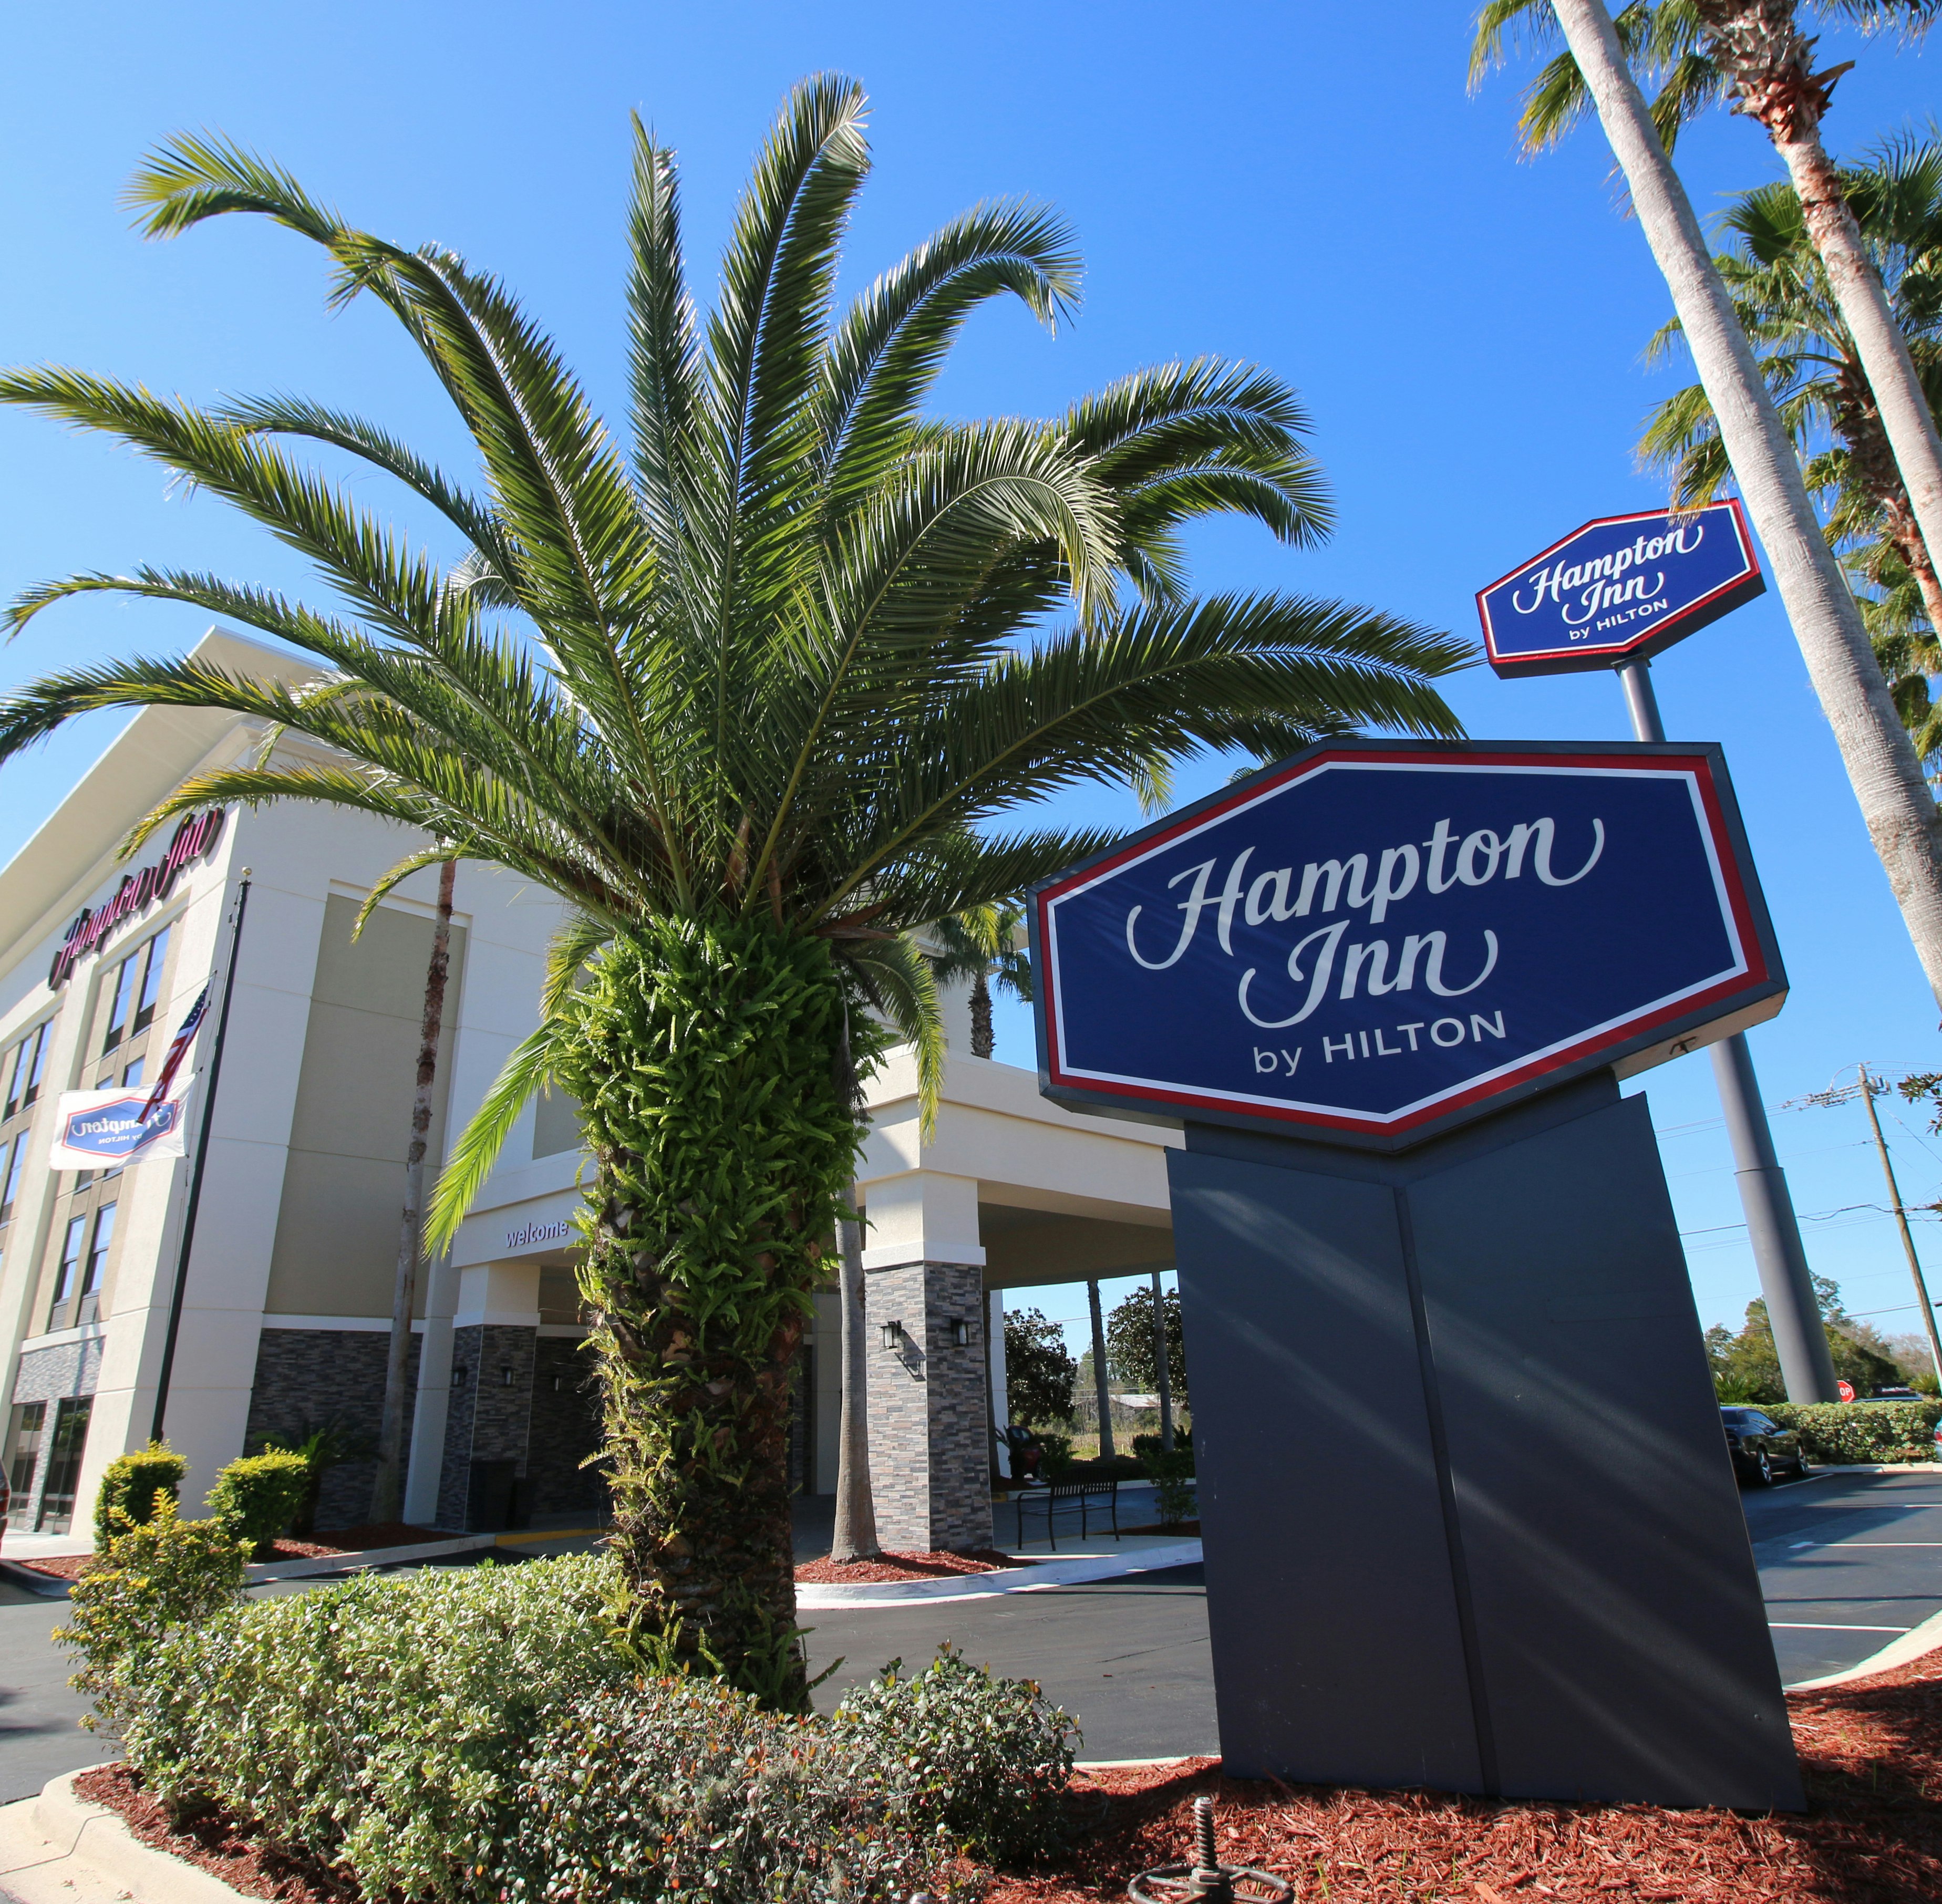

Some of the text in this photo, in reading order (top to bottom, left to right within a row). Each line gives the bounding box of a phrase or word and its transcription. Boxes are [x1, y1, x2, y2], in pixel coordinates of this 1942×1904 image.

[1512, 525, 1703, 614] Hampton
[1561, 572, 1664, 625] Inn
[1569, 598, 1669, 640] by HILTON
[1125, 816, 1605, 970] Hampton
[1238, 919, 1499, 1029] Inn
[1253, 1010, 1506, 1077] by HILTON
[506, 1220, 569, 1248] welcome
[1839, 1386, 1851, 1396] OP
